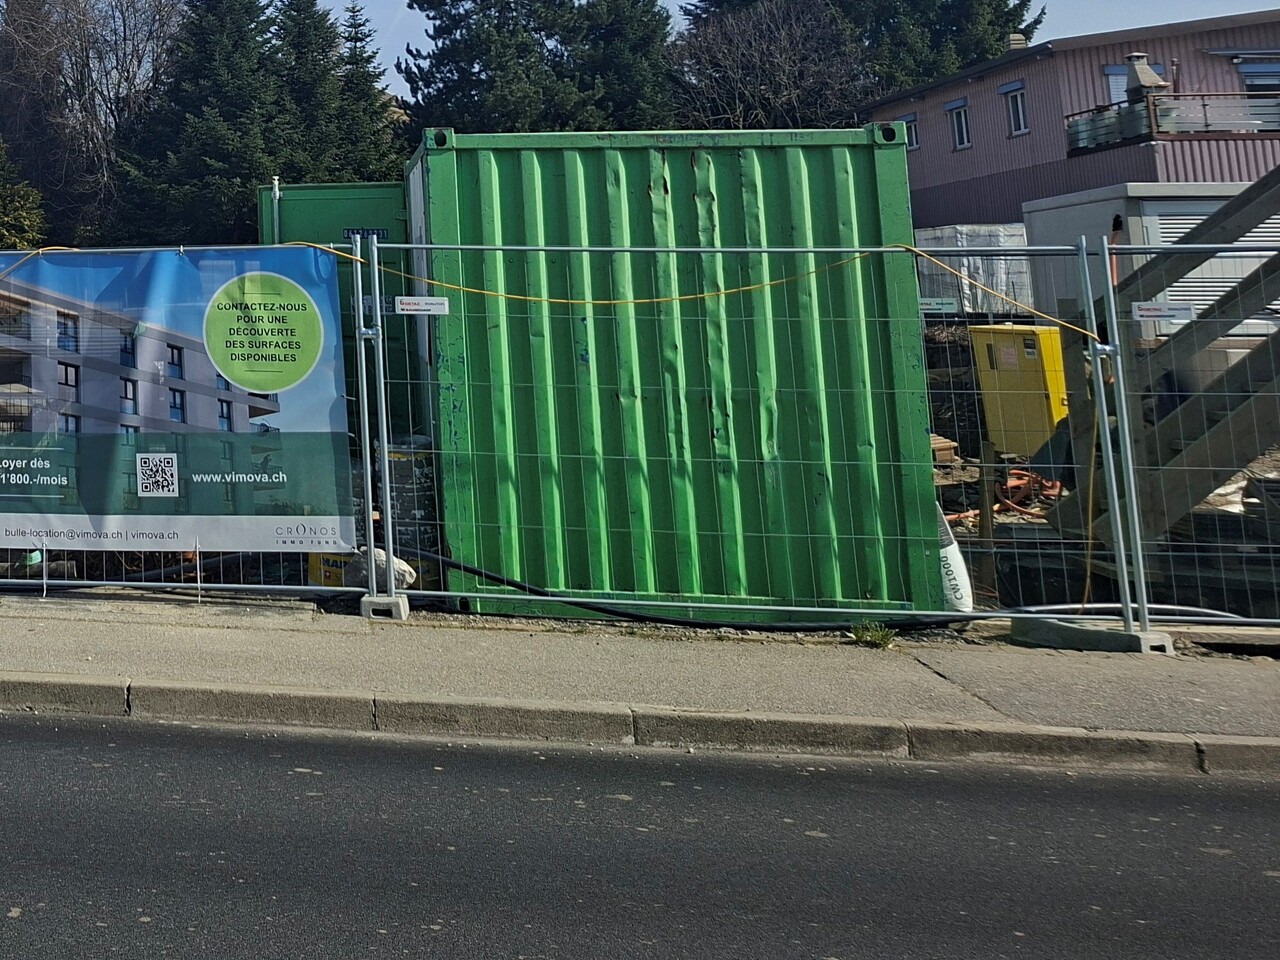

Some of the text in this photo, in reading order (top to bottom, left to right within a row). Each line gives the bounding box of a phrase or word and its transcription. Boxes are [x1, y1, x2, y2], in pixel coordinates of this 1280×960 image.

[217, 302, 307, 312] CONTACTEZ-NOUS
[236, 315, 288, 324] POUR UNE
[228, 326, 297, 337] DÉCOUVERTE
[225, 340, 301, 350] DES SURFACES
[230, 352, 297, 363] DISPONIBLES
[30, 457, 51, 469] dès
[192, 471, 288, 483] www.vimova.ch
[4, 527, 123, 541] bulle-location@vimova.ch
[131, 529, 179, 541] vimova.ch
[275, 523, 338, 536] CRONOS
